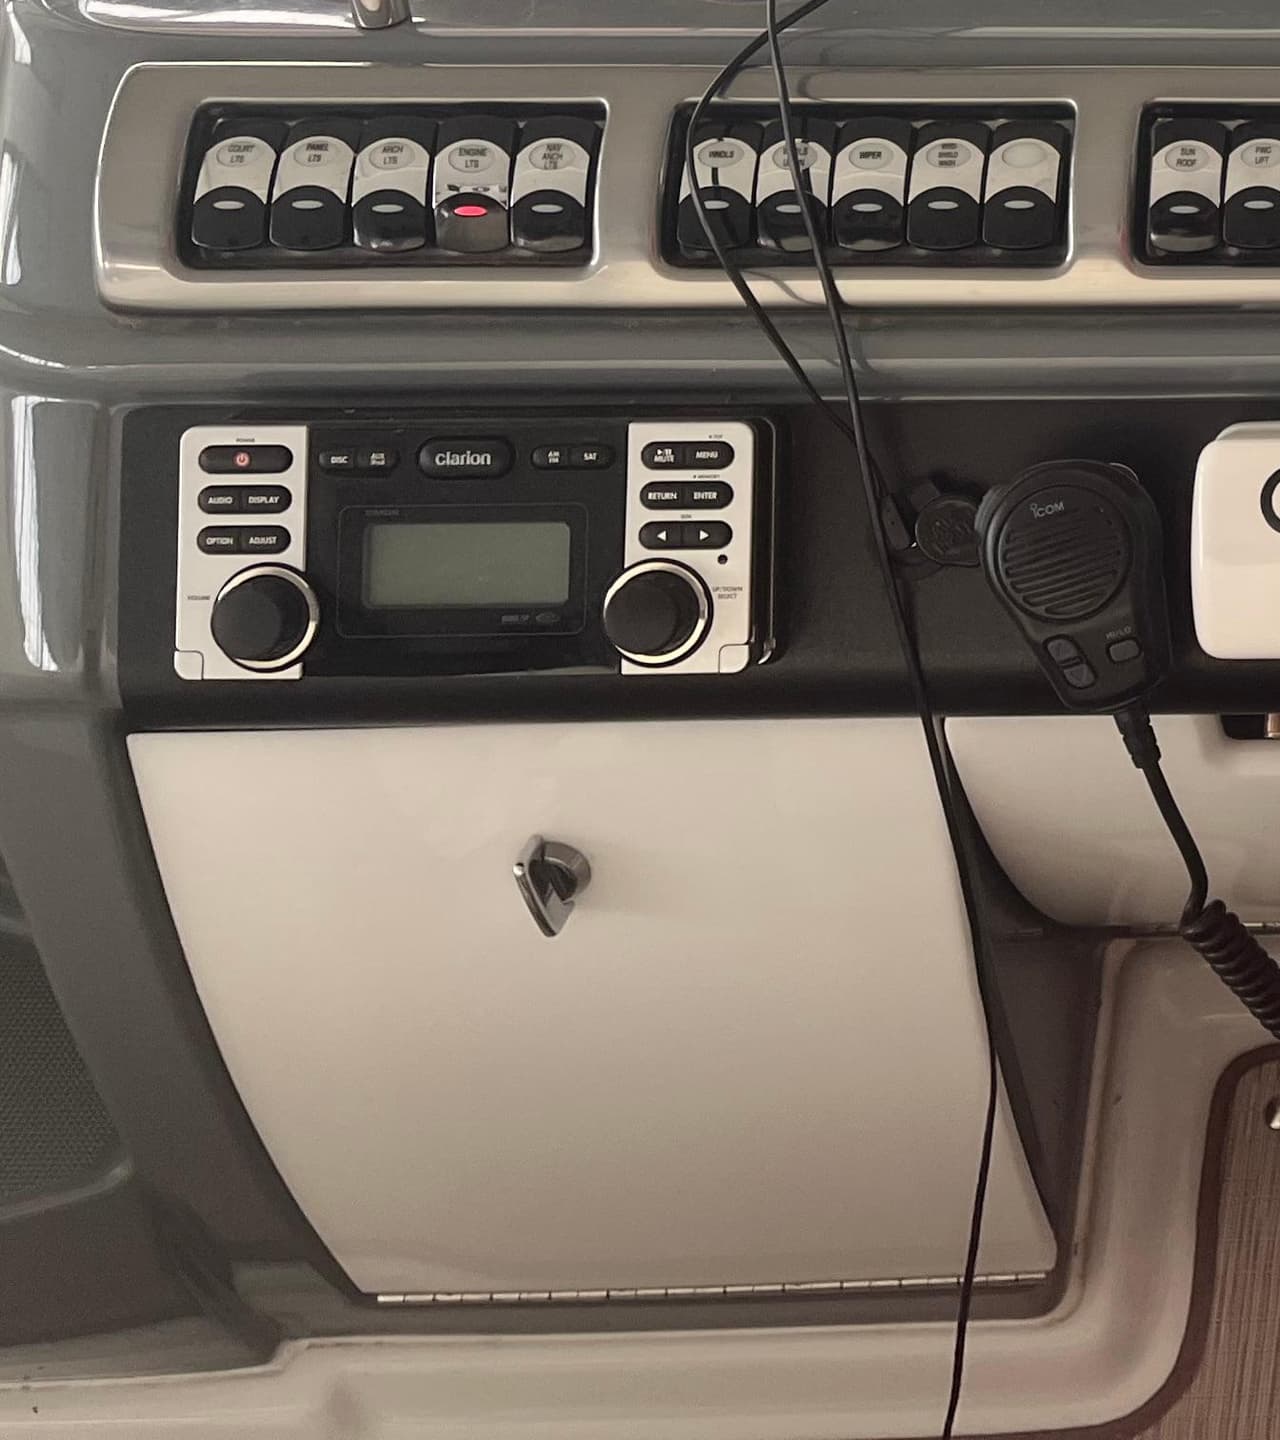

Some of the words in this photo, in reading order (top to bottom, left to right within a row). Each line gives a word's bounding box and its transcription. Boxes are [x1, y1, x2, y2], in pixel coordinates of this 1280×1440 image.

[305, 142, 330, 152] PANEL
[380, 145, 404, 154] ARCH
[458, 146, 489, 157] ENGINE
[858, 150, 883, 160] WIPER
[383, 156, 399, 165] LTS
[464, 159, 480, 169] LTS
[330, 455, 350, 464] DISC
[434, 449, 492, 466] clarion
[583, 452, 598, 462] SAT
[653, 454, 675, 464] MUTE
[695, 450, 719, 460] MENU
[207, 496, 233, 505] AUDIO
[248, 495, 281, 505] DISPLAY
[647, 491, 679, 501] RETURN
[693, 491, 719, 500] ENTER
[205, 536, 234, 546] OPTION
[248, 535, 278, 546] ADJUST
